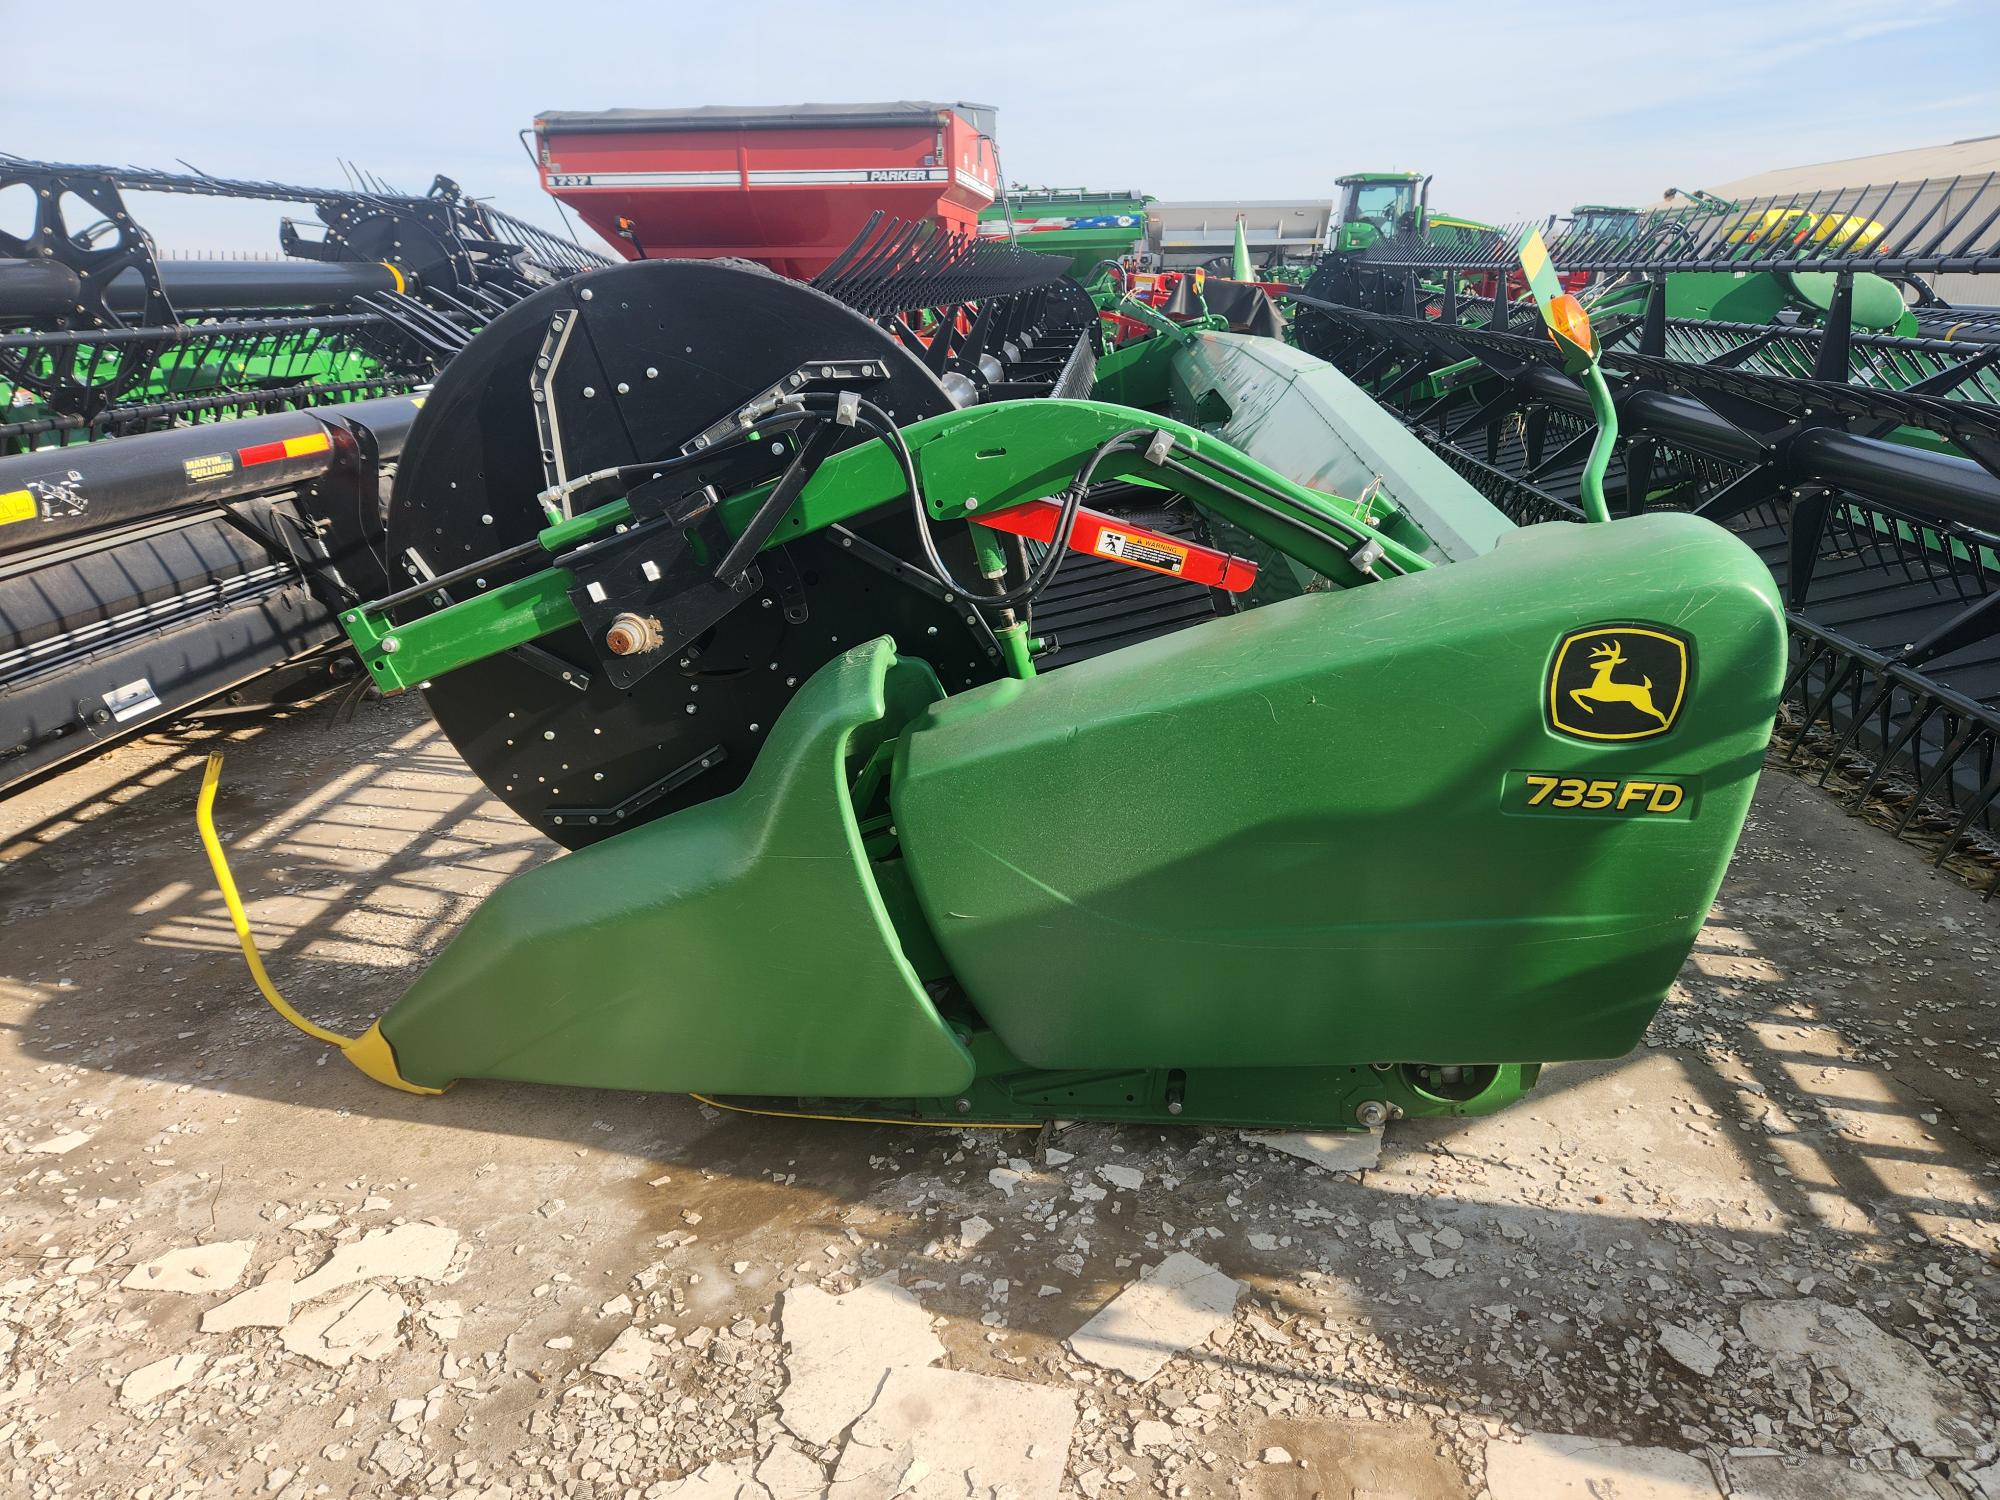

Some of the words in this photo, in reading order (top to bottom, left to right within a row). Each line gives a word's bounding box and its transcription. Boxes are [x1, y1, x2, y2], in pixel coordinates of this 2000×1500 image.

[870, 170, 927, 182] PARKER
[185, 455, 221, 470] MARTIN
[191, 462, 234, 479] SULLIVAN
[1144, 540, 1178, 554] WARNING
[1525, 774, 1685, 813] 735FD
